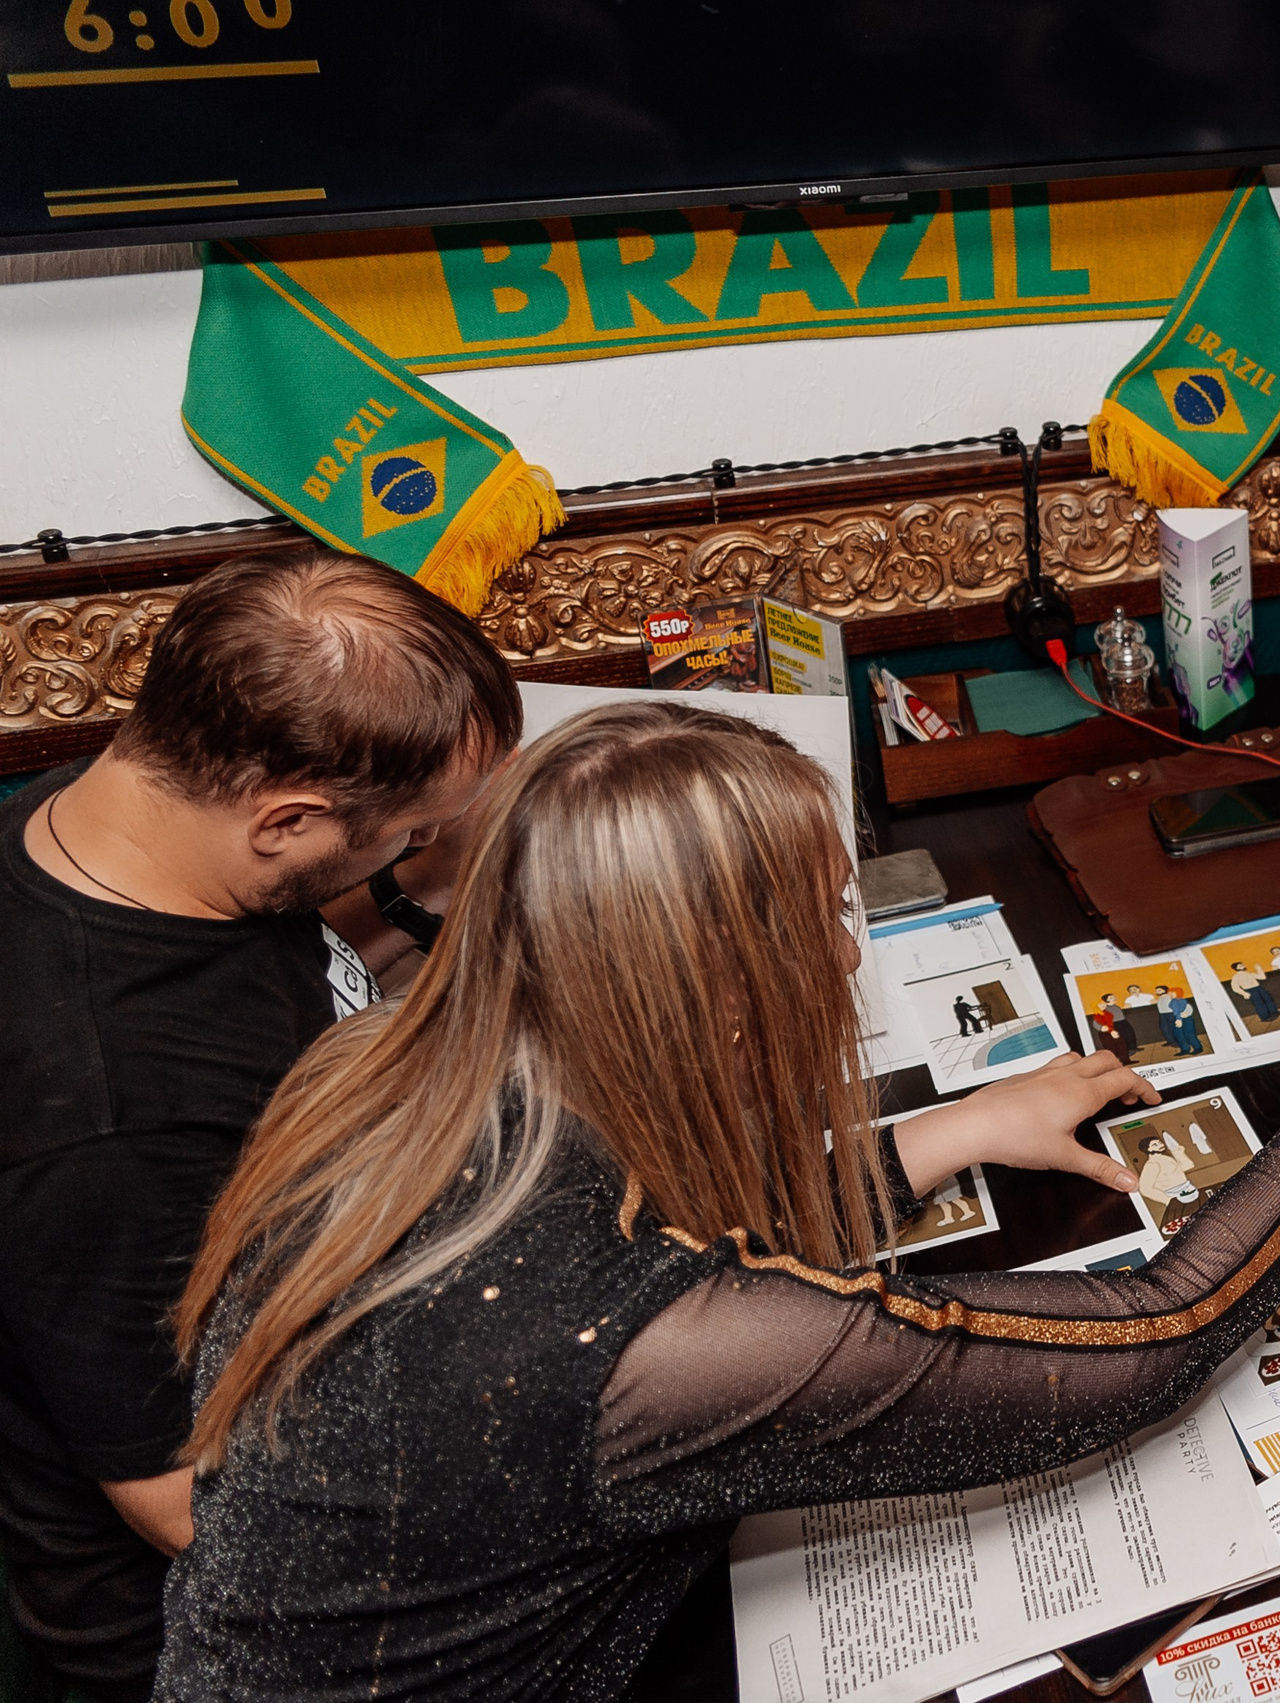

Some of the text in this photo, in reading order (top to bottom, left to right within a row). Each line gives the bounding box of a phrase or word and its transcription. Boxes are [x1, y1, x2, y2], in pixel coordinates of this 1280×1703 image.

[431, 182, 1090, 343] BRAZIL
[1184, 323, 1280, 398] BRAZIL
[302, 398, 398, 502] BRAZIL
[768, 606, 792, 624] ЛЕТНЕЕ
[653, 629, 755, 658] ОПОХМЕЛЬНЫЕ
[768, 617, 820, 644] ПРЕДЛОЖЕНИЕ
[686, 650, 728, 670] ЧАСЫ!
[1005, 962, 1013, 971] 2
[1168, 961, 1181, 972] 4
[1210, 1098, 1223, 1110] 9
[1176, 1432, 1195, 1474] PARTY
[1183, 1416, 1214, 1481] DETECTIVE
[1160, 1646, 1185, 1663] 10%
[1186, 1629, 1231, 1653] скидка
[1232, 1624, 1248, 1638] на
